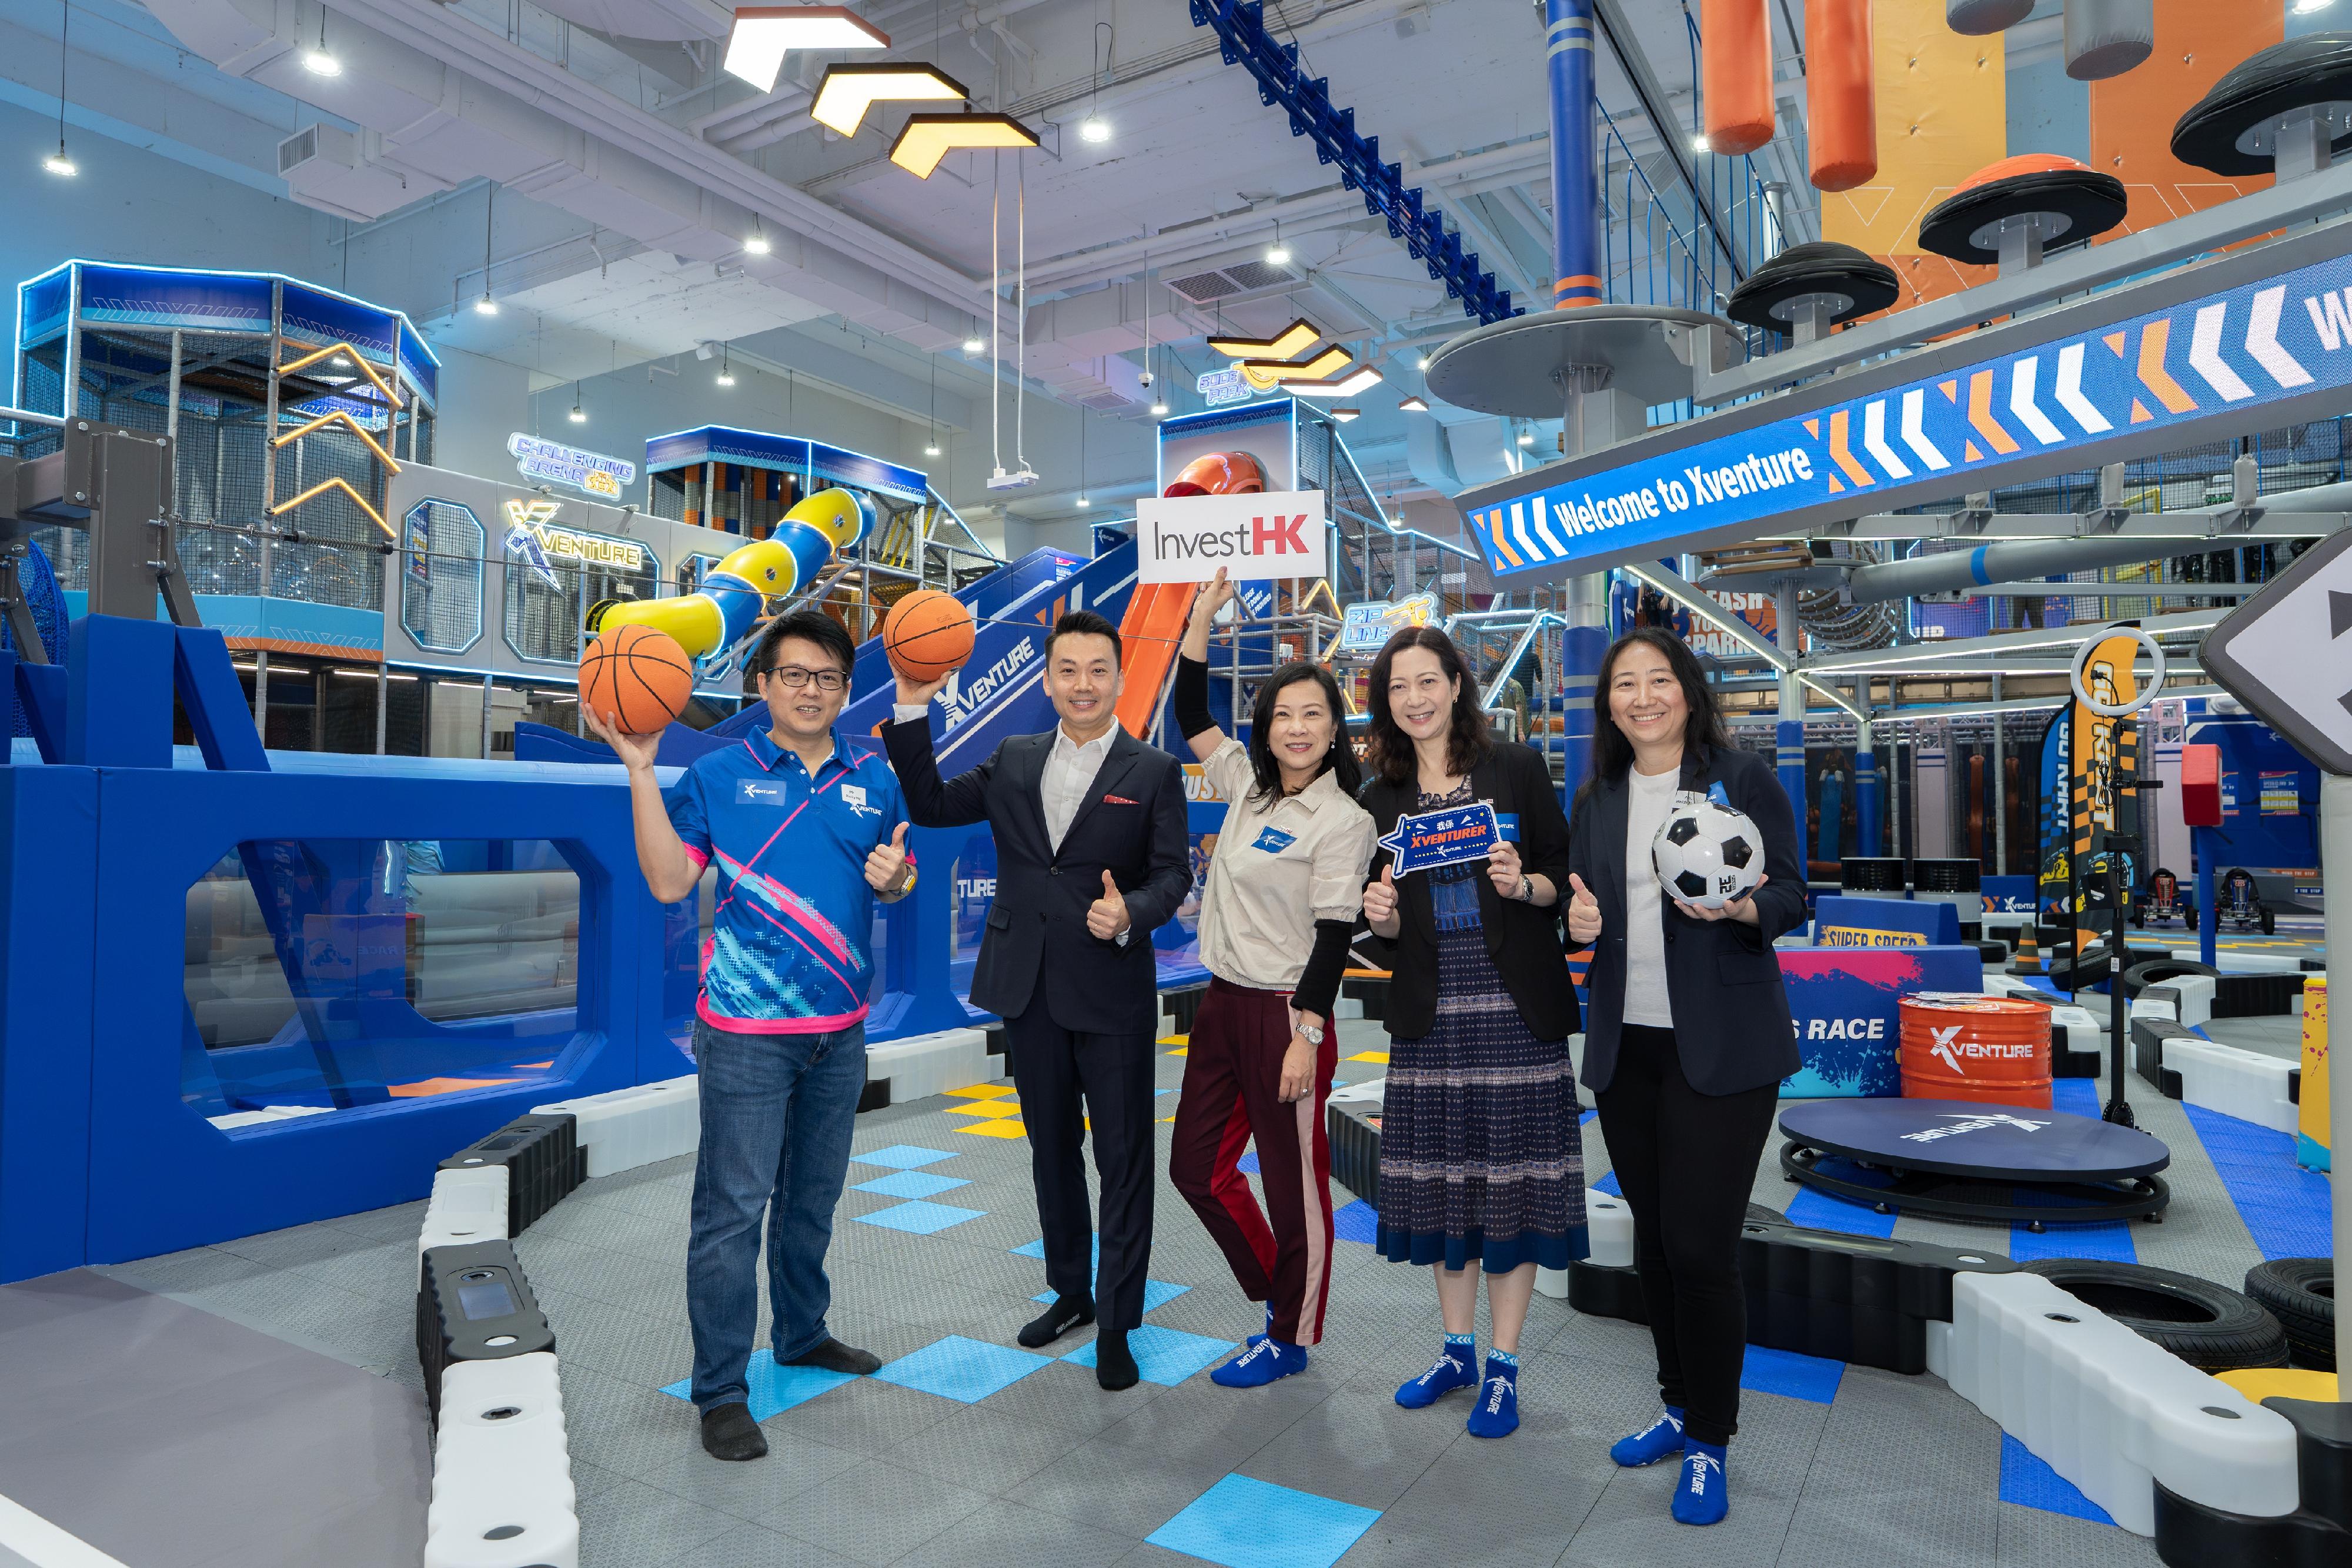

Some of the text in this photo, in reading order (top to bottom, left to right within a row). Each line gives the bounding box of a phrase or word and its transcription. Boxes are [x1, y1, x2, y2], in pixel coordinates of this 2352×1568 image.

[1209, 383, 1247, 402] PARK
[517, 439, 633, 478] CHALLENGING
[527, 457, 585, 482] ARENA
[1553, 447, 1814, 538] Welcome to Xventure
[1154, 514, 1309, 560] InvestHK
[1242, 587, 1255, 602] LEASE
[1349, 608, 1383, 624] ZIP
[1345, 626, 1389, 642] LINE
[1182, 775, 1223, 800] US
[1411, 824, 1486, 848] XVENTURER
[1436, 820, 1454, 831] 我係
[1808, 1018, 1885, 1040] RACE
[1930, 1025, 2033, 1075] XVENTURE
